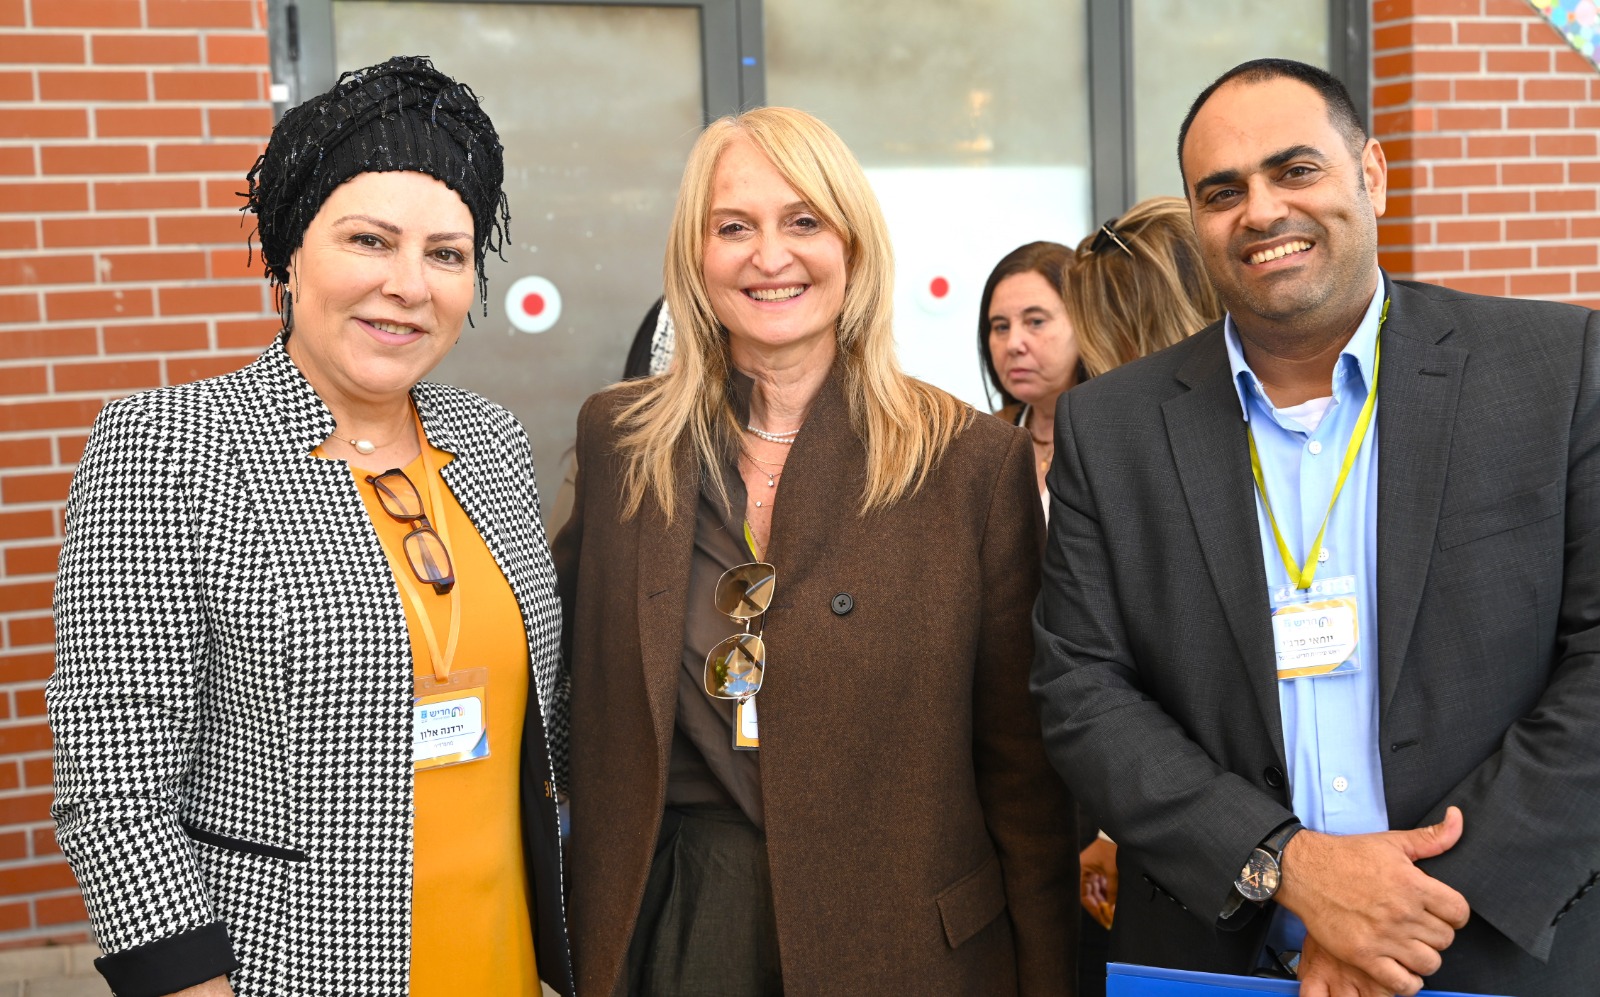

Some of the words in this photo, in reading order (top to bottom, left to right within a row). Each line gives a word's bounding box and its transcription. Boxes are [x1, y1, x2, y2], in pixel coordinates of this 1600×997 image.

[1293, 617, 1317, 627] חריש
[1308, 635, 1334, 645] יוחאי
[429, 708, 451, 718] חריש
[420, 728, 439, 740] אלון
[440, 724, 464, 735] ירדנה
